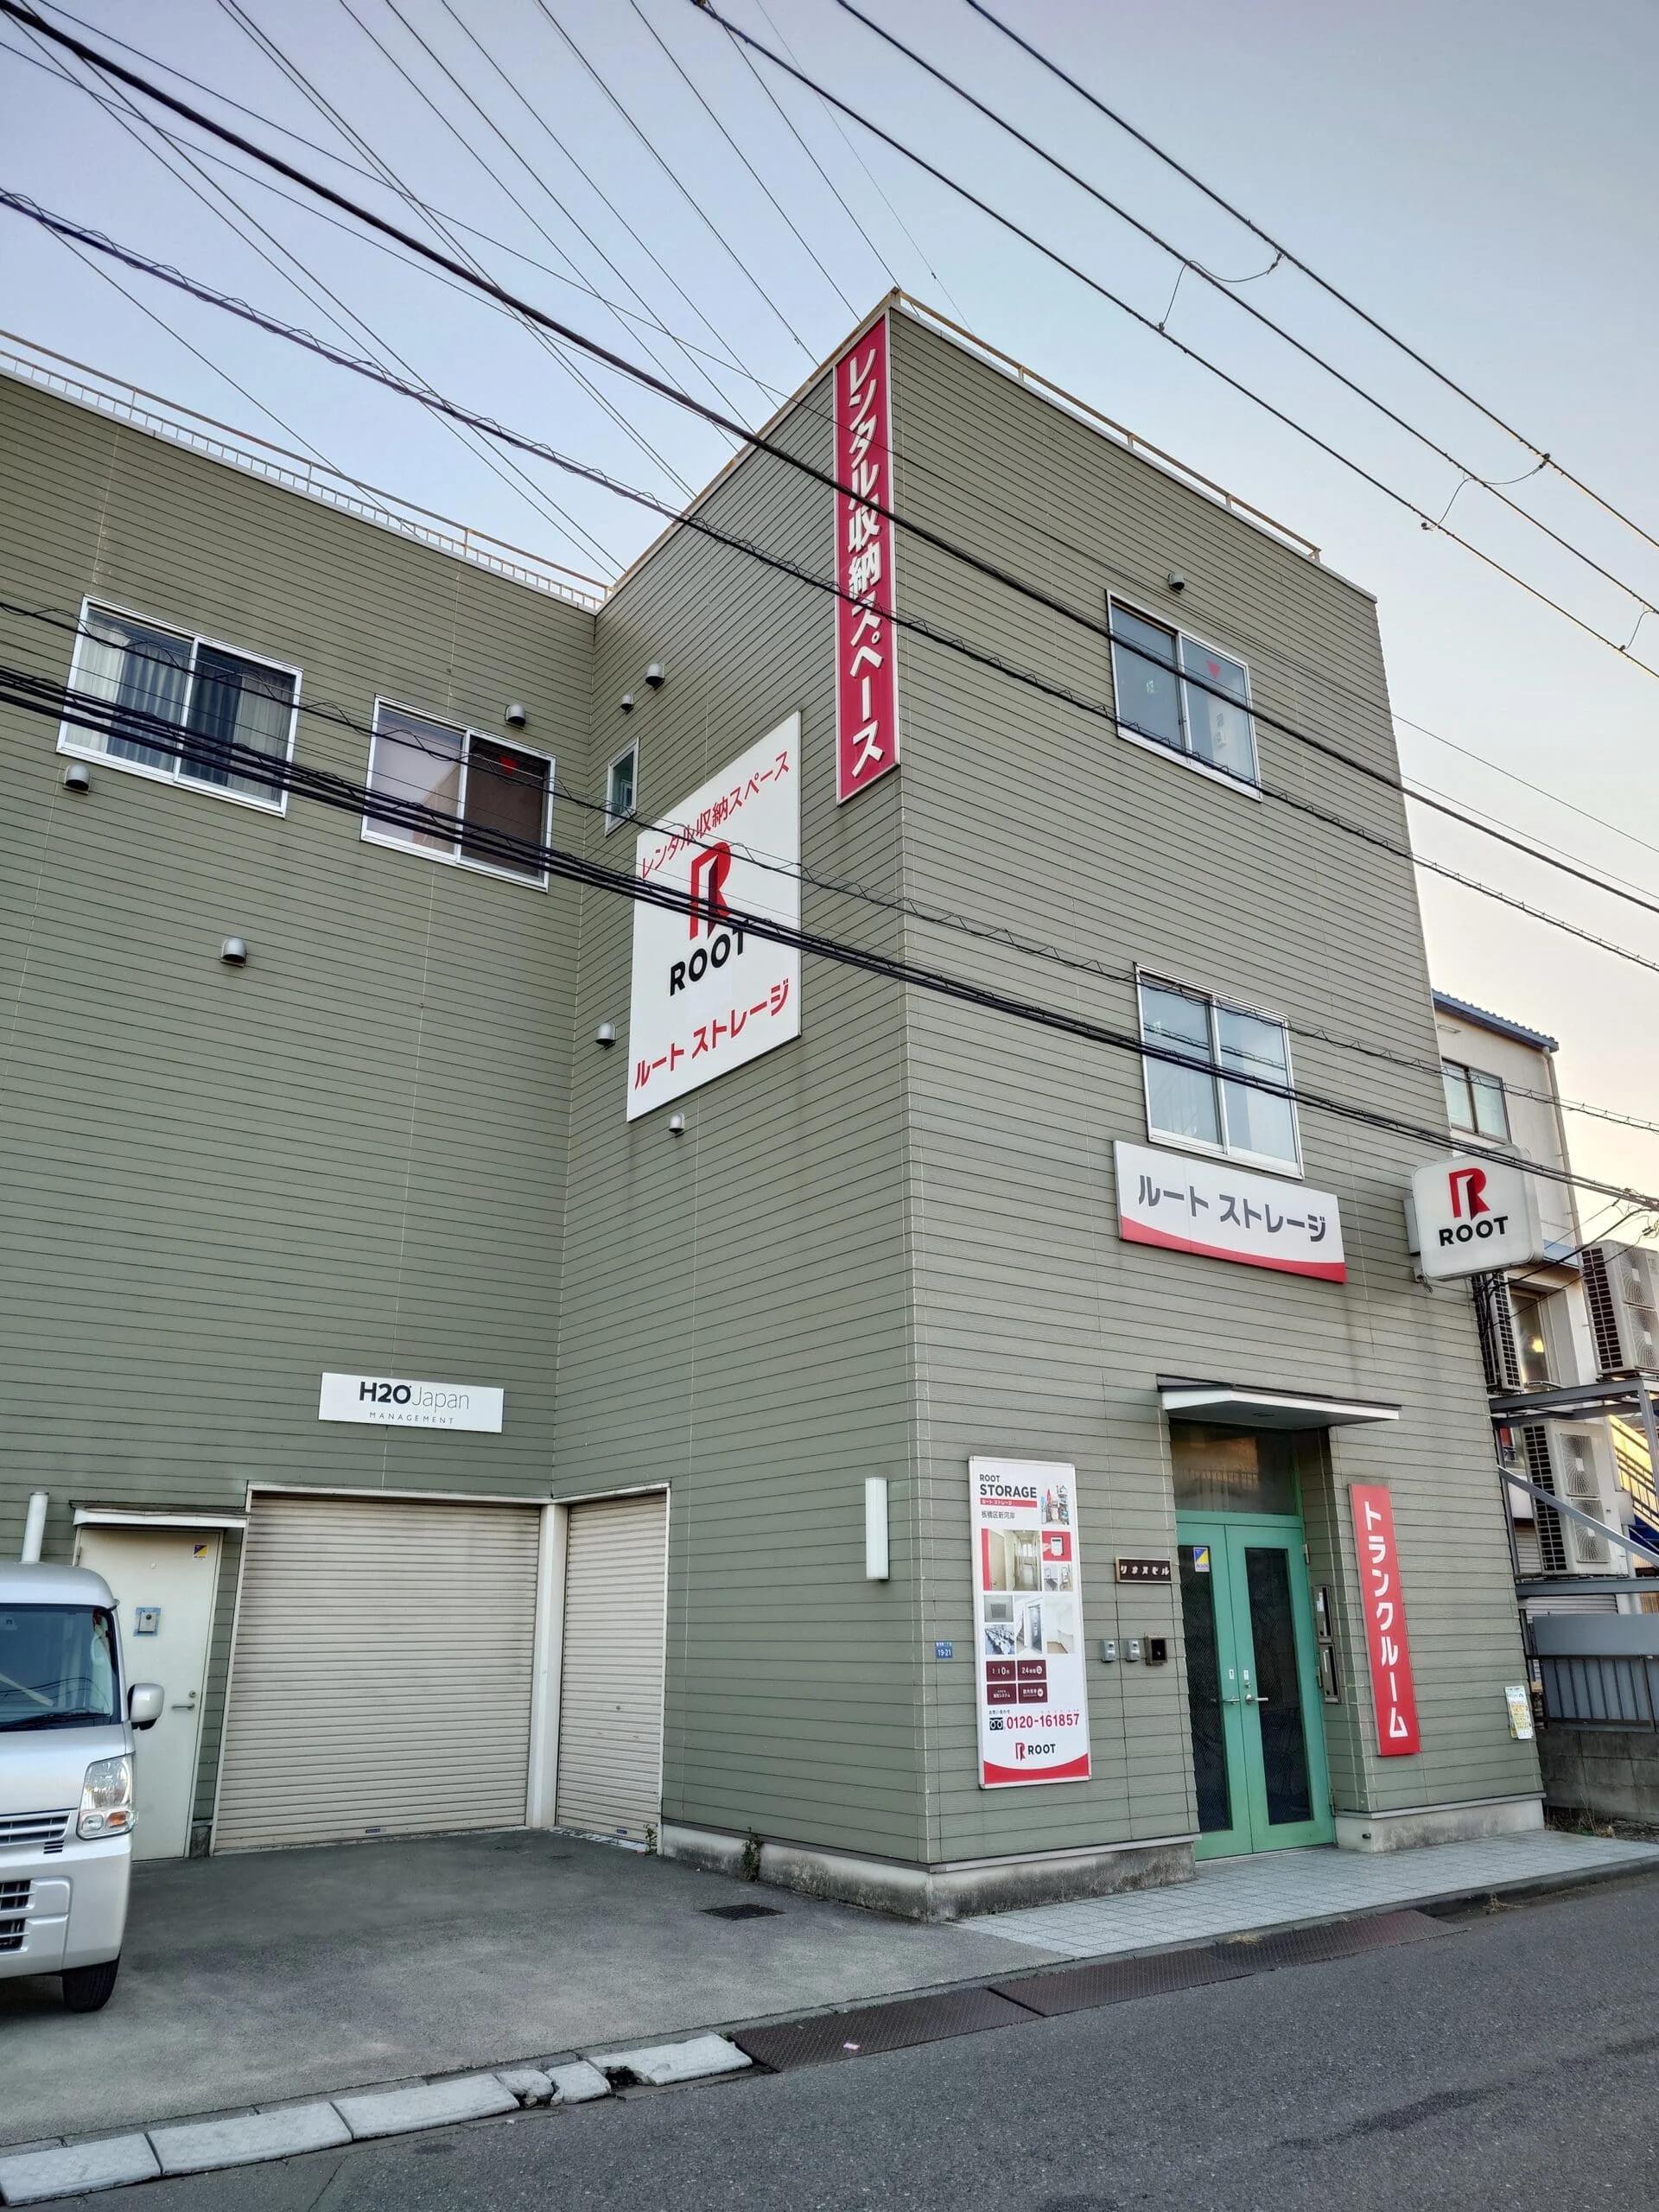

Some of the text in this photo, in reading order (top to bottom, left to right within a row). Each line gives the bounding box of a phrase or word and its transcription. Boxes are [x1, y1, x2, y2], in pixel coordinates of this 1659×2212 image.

[849, 347, 883, 778] レンタル収納スペース
[643, 751, 790, 879] レンタル収納スペース
[670, 920, 749, 996] ROOT
[635, 978, 789, 1090] ルート ストレージ
[1138, 1174, 1325, 1243] ルート ストレージ
[1438, 1215, 1509, 1247] ROOT
[369, 1411, 454, 1425] MANAGEMENT
[979, 1474, 1001, 1483] ROOT
[980, 1484, 1038, 1498] STORAGE
[1363, 1501, 1408, 1738] トランクルーム
[1007, 1713, 1080, 1730] 0120-161857
[1027, 1743, 1056, 1756] ROOT
